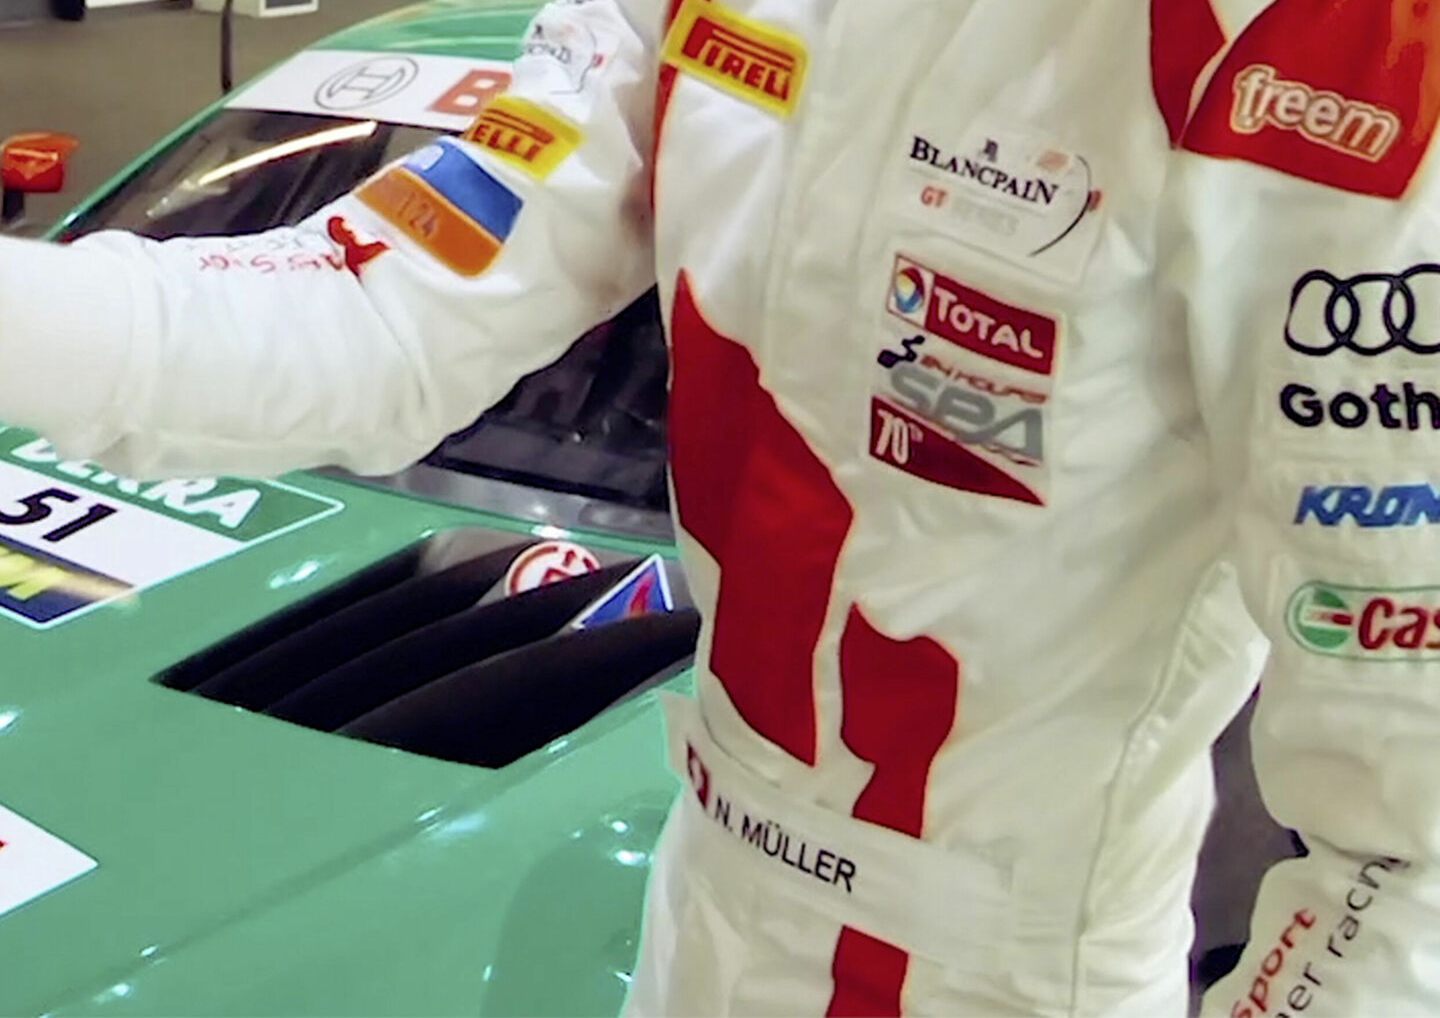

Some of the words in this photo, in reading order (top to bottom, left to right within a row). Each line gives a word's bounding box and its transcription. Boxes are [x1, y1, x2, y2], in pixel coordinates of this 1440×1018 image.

[1235, 66, 1396, 158] freem
[910, 136, 1059, 205] BLANCPAIN
[933, 285, 1044, 359] TOTAL
[740, 813, 857, 894] MÜLLER
